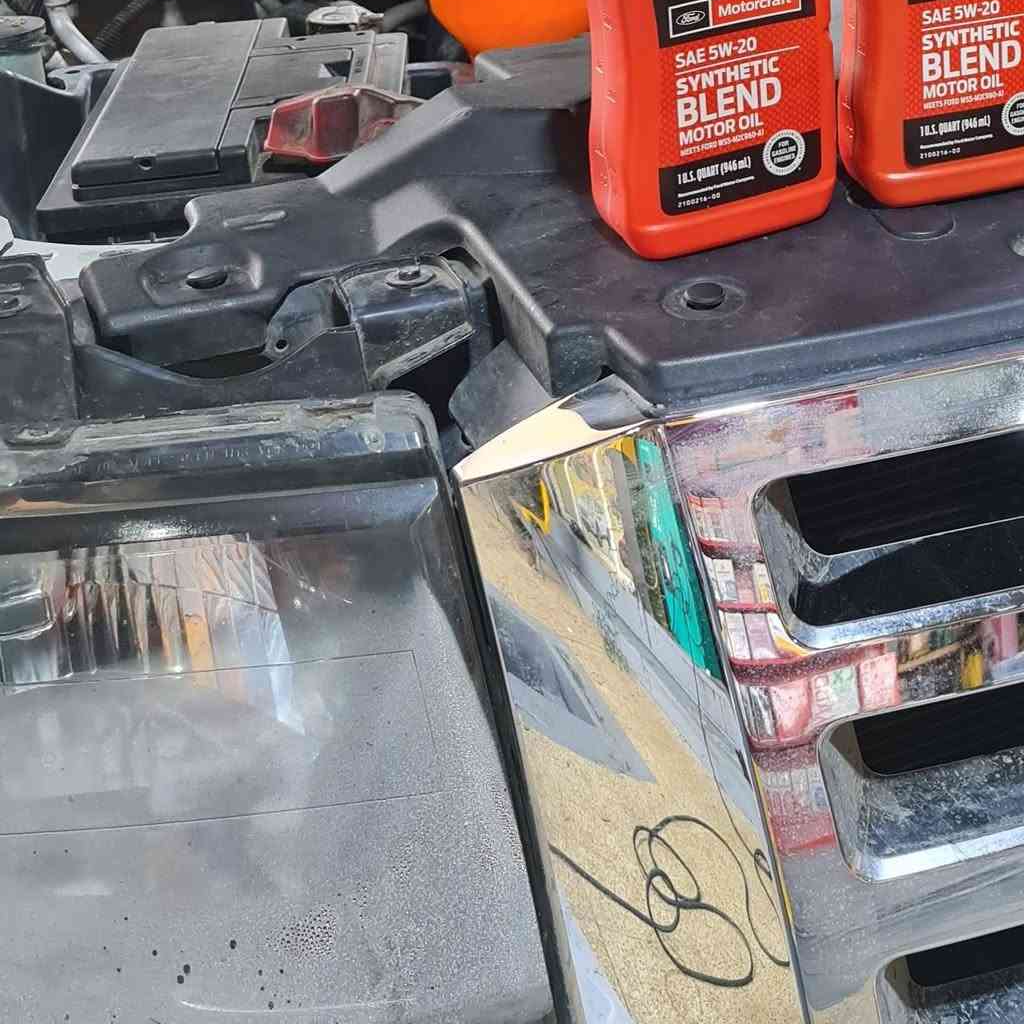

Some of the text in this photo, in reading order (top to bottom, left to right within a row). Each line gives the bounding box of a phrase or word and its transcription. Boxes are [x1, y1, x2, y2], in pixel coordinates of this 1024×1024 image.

[680, 11, 701, 25] Ford
[922, 0, 1001, 25] SAE 5W-20
[921, 20, 1021, 51] SYNTHETIC
[675, 36, 758, 69] SAE 5W-20
[922, 39, 1023, 83] BLEND
[675, 56, 780, 96] SYNTHETIC
[923, 73, 1004, 100] MOTOR OIL
[676, 76, 783, 129] BLEND
[679, 112, 764, 146] MOTOR OIL
[919, 125, 924, 136] 1
[924, 123, 938, 136] U.S.
[938, 119, 961, 136] QUART
[677, 174, 682, 185] 1
[682, 170, 697, 184] U.S.
[696, 163, 720, 182] QUART
[720, 159, 738, 176] (946
